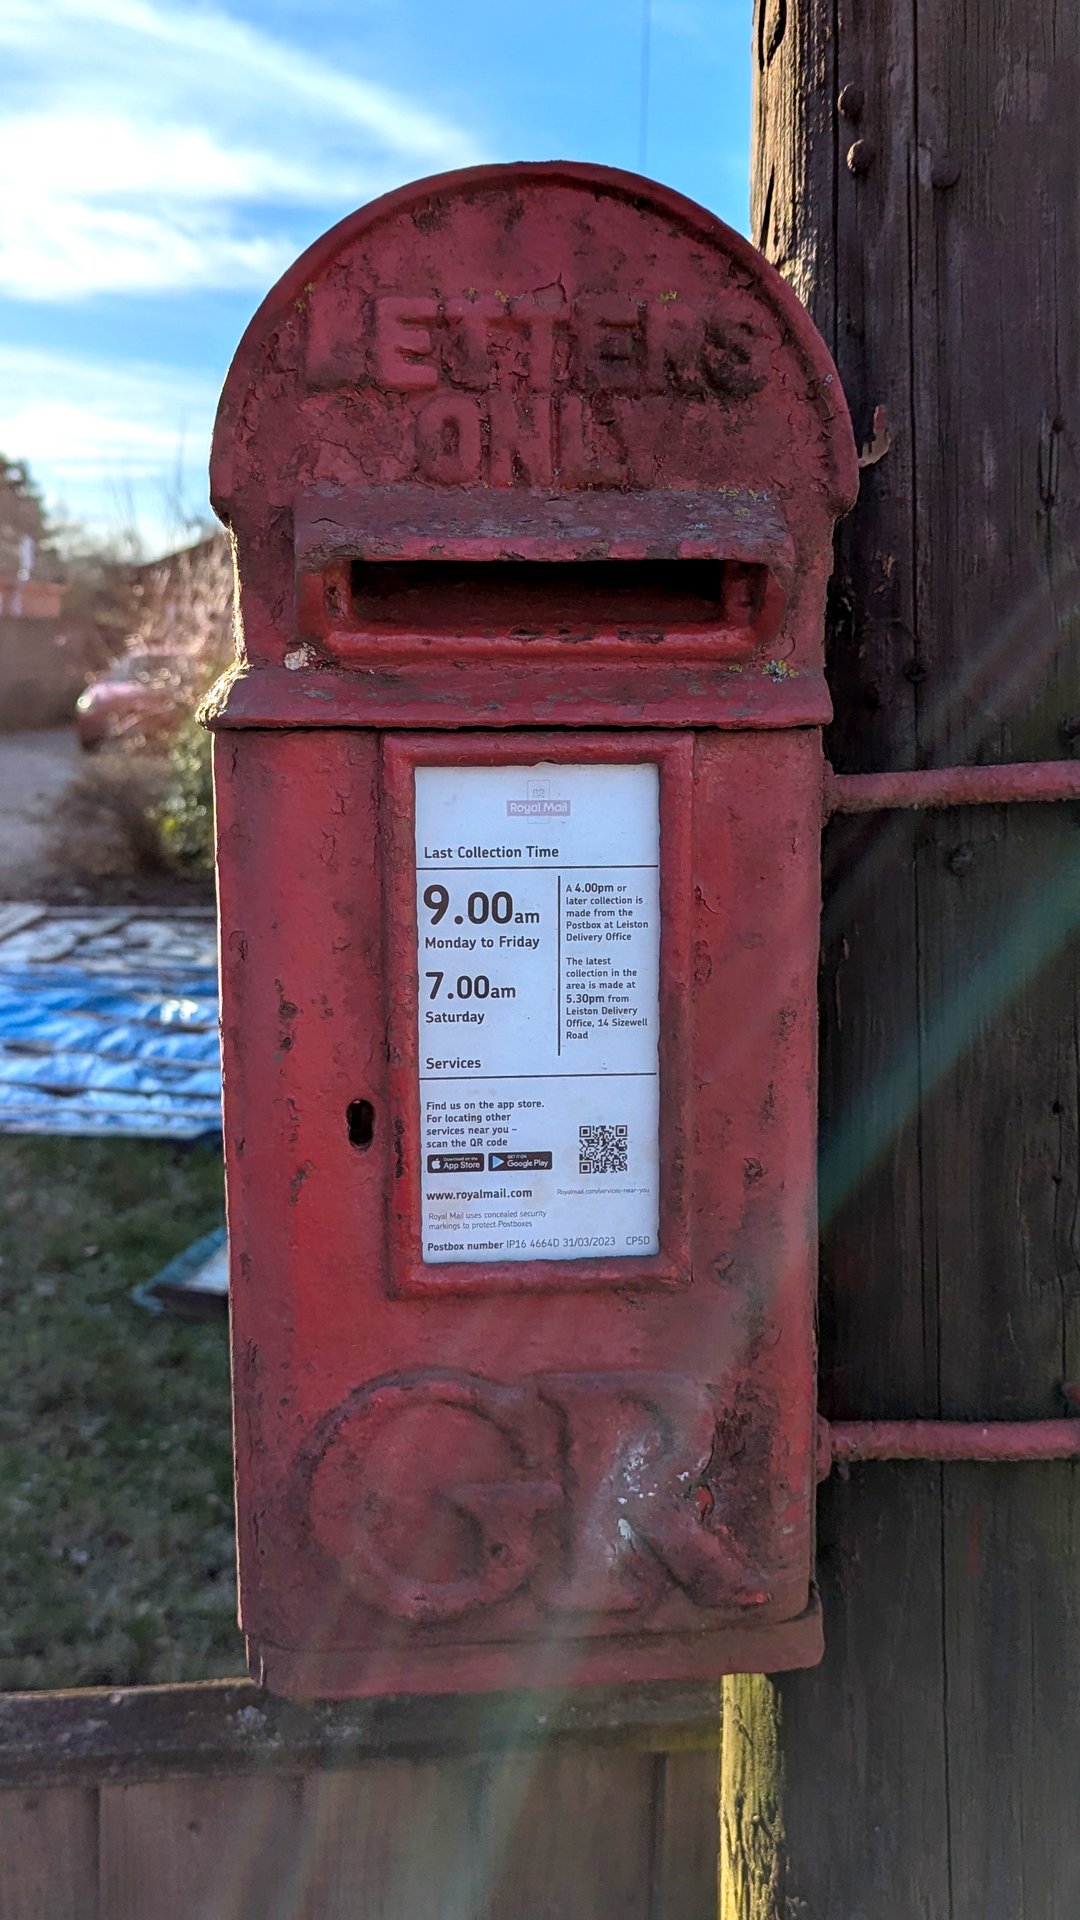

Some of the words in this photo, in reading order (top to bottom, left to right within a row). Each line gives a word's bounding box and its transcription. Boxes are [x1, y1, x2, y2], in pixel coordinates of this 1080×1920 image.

[510, 801, 541, 815] Royal
[543, 801, 568, 813] Mail
[424, 846, 453, 859] Last
[457, 846, 522, 859] Collection
[525, 845, 560, 858] Time
[565, 884, 573, 893] A
[574, 882, 614, 895] 4.00pm
[616, 884, 627, 893] or
[422, 884, 540, 925] 9.00am
[566, 896, 588, 905] later
[589, 896, 633, 905] collection
[635, 896, 644, 905] is
[566, 908, 591, 918] made
[593, 908, 616, 917] from
[618, 908, 633, 917] the
[566, 920, 602, 930] Postbox
[603, 921, 614, 929] at
[616, 920, 649, 929] Leiston
[425, 936, 476, 951] Monday
[480, 936, 494, 949] to
[499, 935, 540, 950] Friday
[566, 933, 603, 943] Delivery
[605, 932, 632, 942] Office
[566, 957, 583, 966] The
[585, 956, 612, 966] latest
[566, 969, 609, 978] collection
[611, 969, 620, 977] in
[622, 968, 637, 977] the
[425, 971, 516, 1000] 7.00am
[566, 981, 586, 990] area
[588, 980, 596, 989] is
[598, 980, 624, 989] made
[626, 980, 636, 989] at
[566, 993, 605, 1006] 5.30pm
[607, 994, 630, 1003] from
[566, 1006, 599, 1016] Leiston
[601, 1006, 638, 1016] Delivery
[425, 1010, 485, 1025] Saturday
[566, 1018, 595, 1029] Office,
[597, 1018, 609, 1027] 14
[611, 1018, 648, 1027] Sizewell
[566, 1031, 589, 1040] Road
[426, 1057, 482, 1070] Services
[426, 1101, 447, 1111] Find
[449, 1102, 462, 1110] us
[463, 1101, 476, 1110] on
[478, 1100, 495, 1109] the
[497, 1100, 515, 1111] app
[517, 1099, 545, 1109] store.
[426, 1113, 443, 1123] For
[445, 1113, 483, 1124] locating
[485, 1113, 511, 1122] other
[426, 1125, 465, 1136] services
[467, 1125, 490, 1135] near
[491, 1126, 509, 1135] you
[426, 1139, 449, 1148] scan
[450, 1138, 467, 1148] the
[469, 1138, 484, 1148] QR
[486, 1138, 508, 1147] code
[443, 1161, 459, 1170] App
[460, 1160, 481, 1169] Store
[506, 1159, 533, 1169] Google
[533, 1158, 549, 1168] Play
[426, 1188, 533, 1202] www.royalmail.com
[428, 1212, 448, 1221] Royal
[449, 1211, 464, 1220] Mail
[484, 1210, 518, 1219] concealed
[519, 1209, 547, 1218] security
[428, 1221, 461, 1230] markings
[471, 1221, 496, 1230] protect
[497, 1220, 533, 1228] Postboxes
[427, 1241, 465, 1252] Postbox
[467, 1241, 504, 1250] number
[506, 1239, 527, 1249] IP16
[563, 1236, 616, 1247] 31/03/2023
